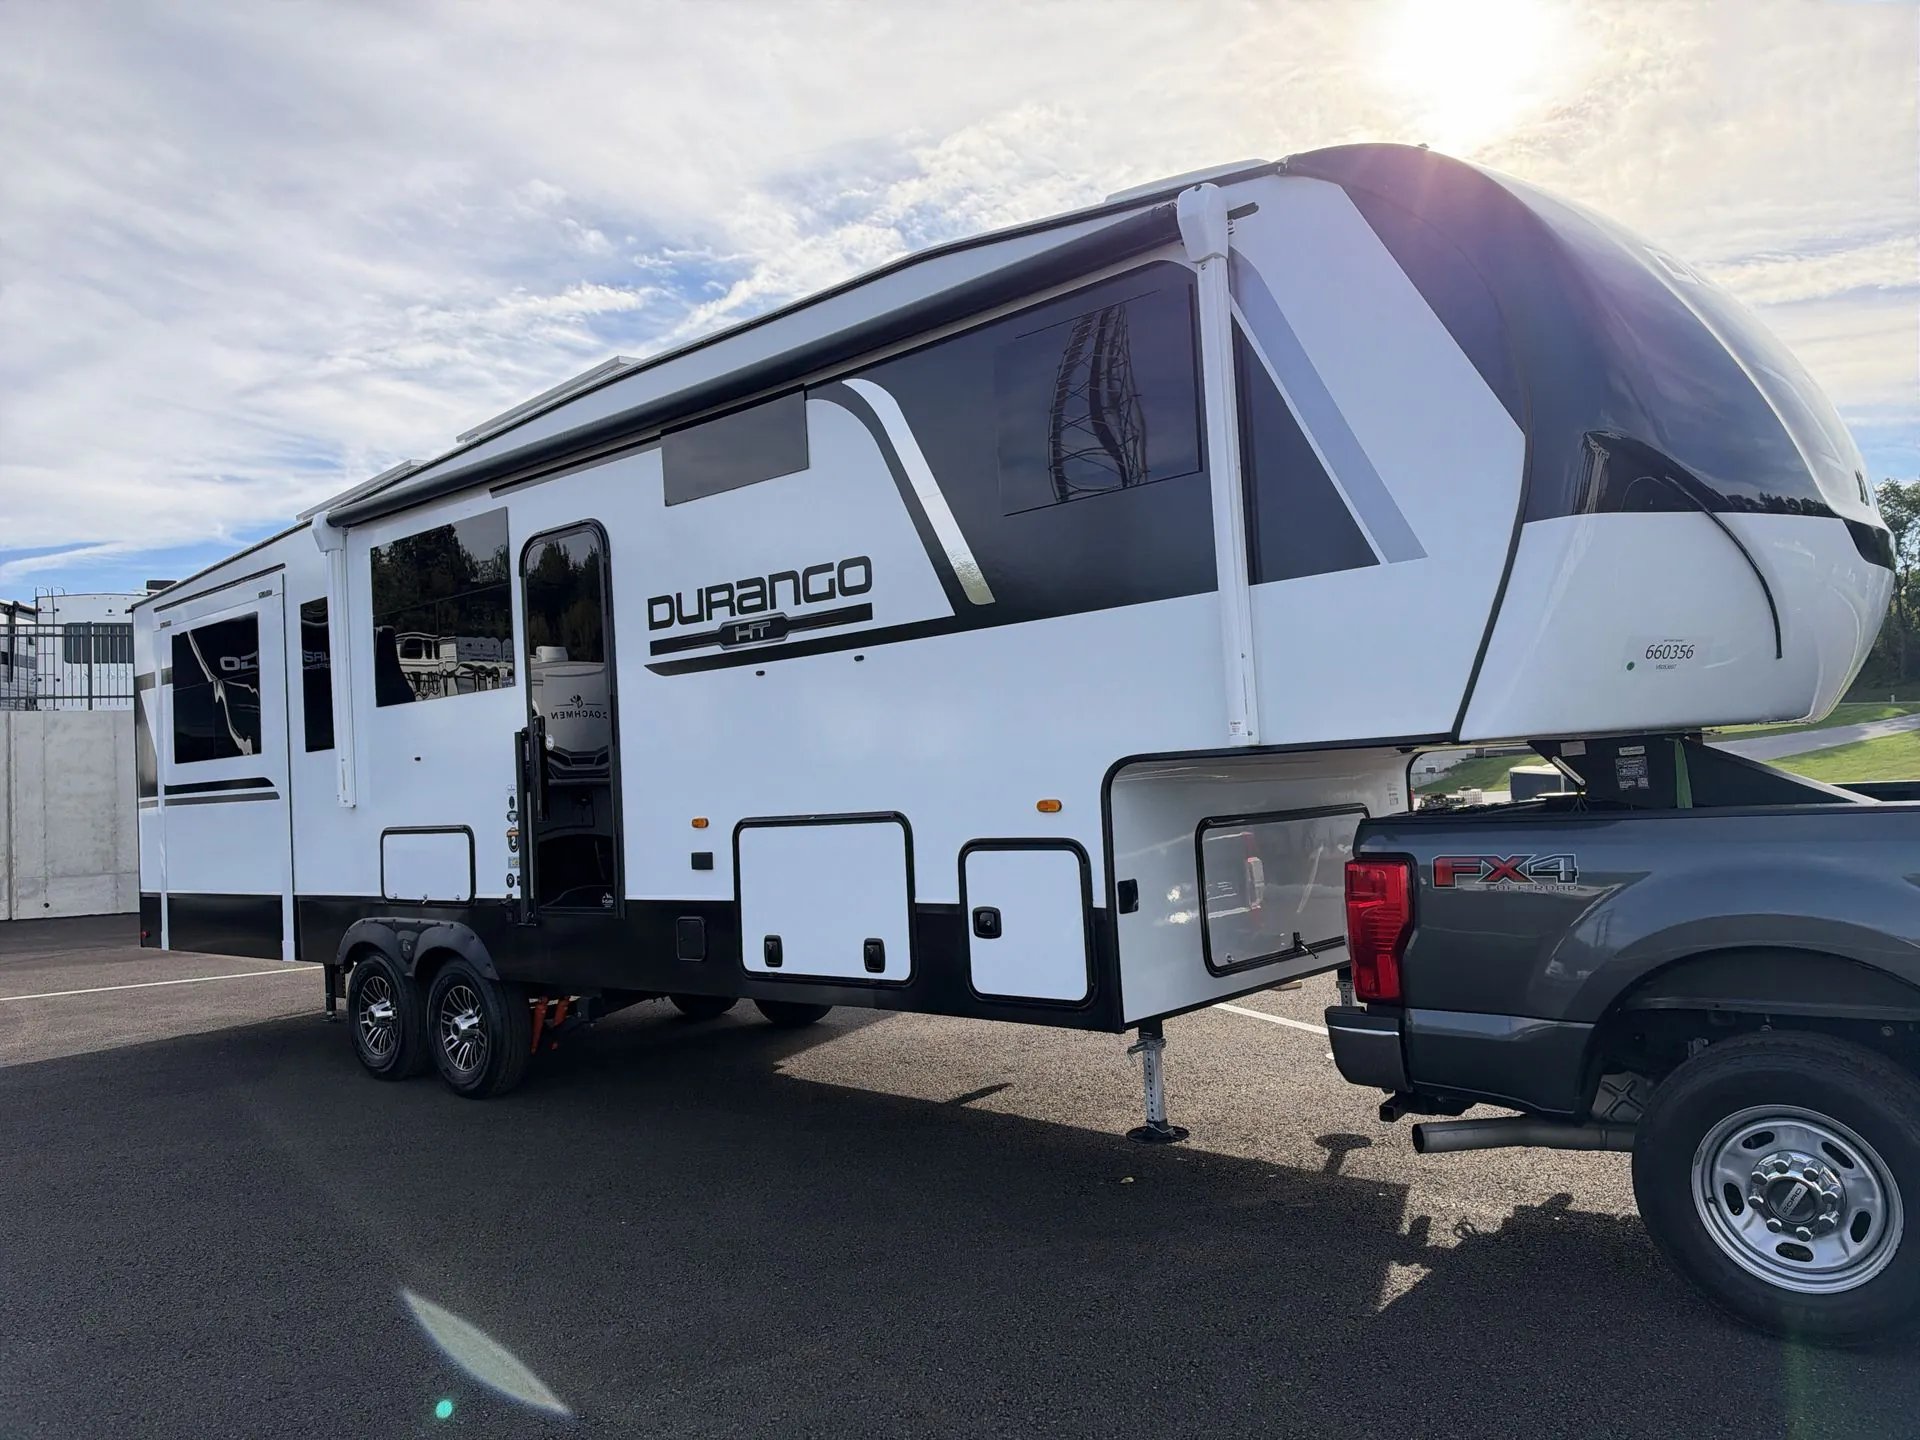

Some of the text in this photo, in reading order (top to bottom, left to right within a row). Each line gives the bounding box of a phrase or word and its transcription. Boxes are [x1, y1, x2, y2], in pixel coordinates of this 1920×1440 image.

[647, 555, 873, 631] DURANGO
[735, 621, 771, 642] HT
[1645, 644, 1696, 660] 660356
[1432, 854, 1579, 889] FX4
[1782, 1187, 1803, 1213] FORD
